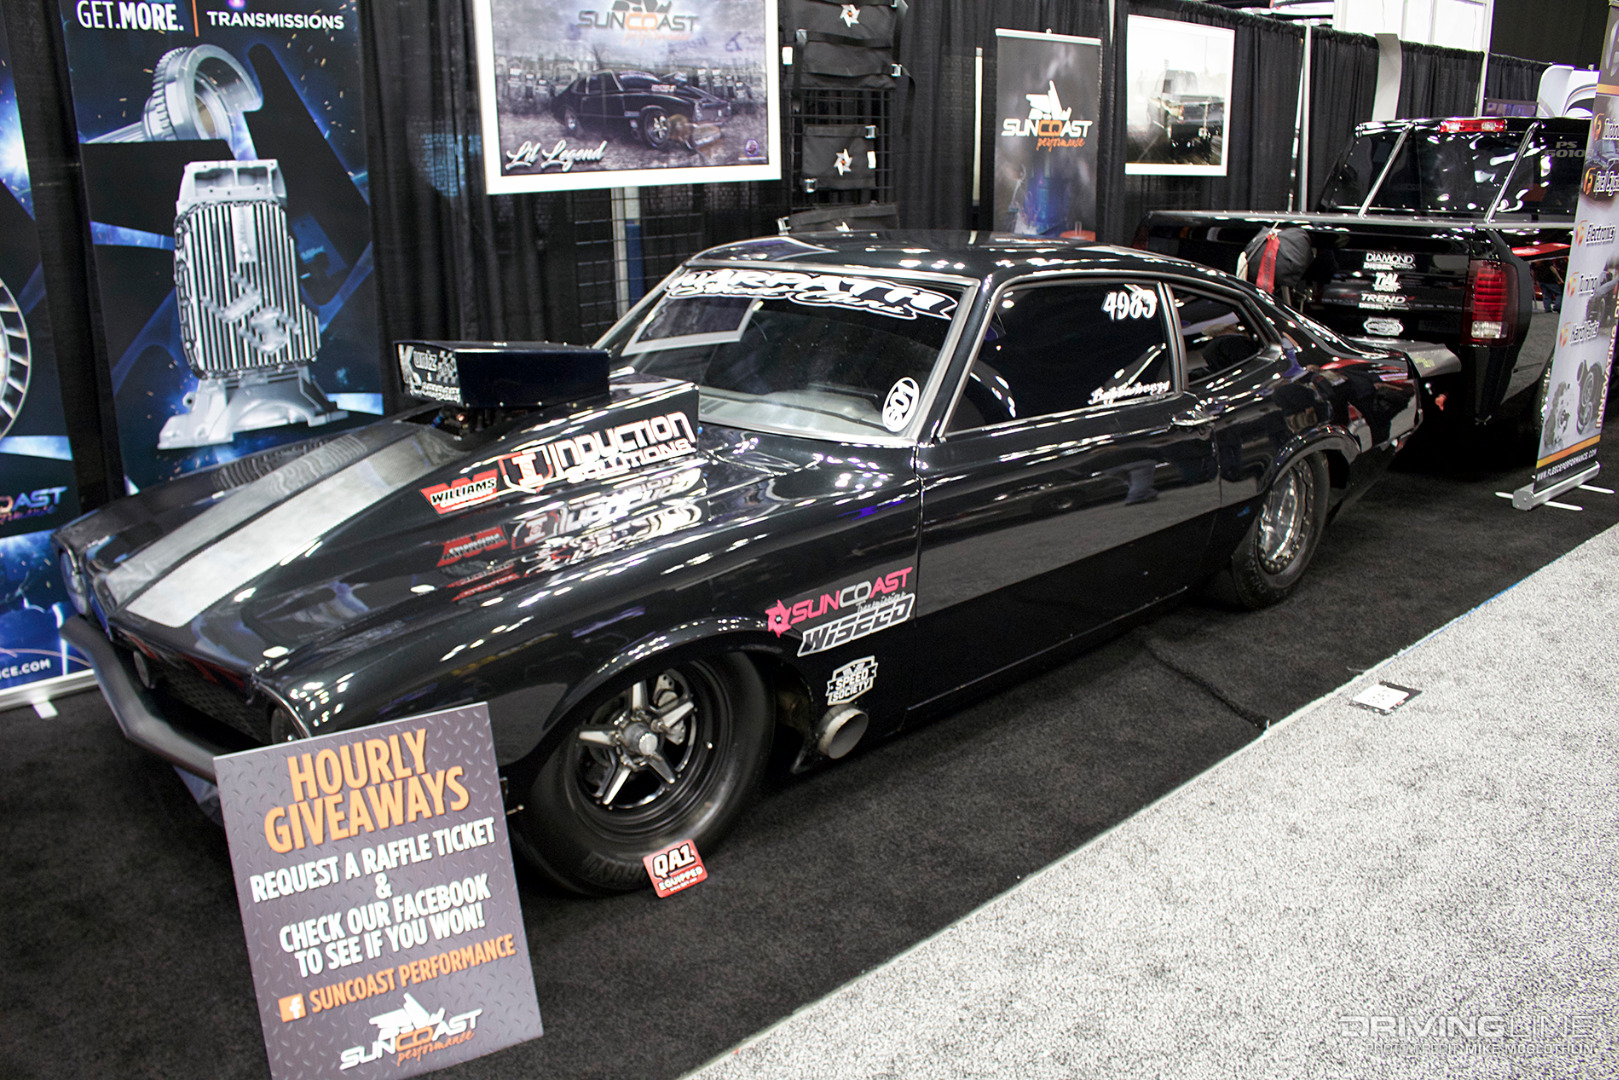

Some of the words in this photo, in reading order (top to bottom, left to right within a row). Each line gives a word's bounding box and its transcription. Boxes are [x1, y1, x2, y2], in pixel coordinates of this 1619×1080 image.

[206, 11, 345, 29] TRANSMISSIONS
[576, 10, 699, 31] SUNCOAST
[1001, 118, 1093, 137] SUNCOAST
[1555, 141, 1578, 149] PS
[505, 140, 541, 170] Lil
[541, 139, 608, 172] Legend
[1585, 223, 1616, 244] Electronics
[1366, 251, 1414, 264] DIAMOND
[668, 269, 950, 312] WARPATH
[1361, 293, 1406, 303] TREND
[1595, 325, 1618, 429] INNOVATING
[548, 411, 697, 479] INDUCTION
[564, 438, 697, 484] SOLUTIONS
[431, 478, 497, 504] WILLIAMS
[790, 566, 914, 625] SUNCOAST
[832, 679, 871, 702] SOCIETY
[834, 669, 869, 691] SPEED
[287, 728, 427, 802] HOURLY
[264, 765, 470, 853] GIVEAWAYS
[250, 856, 339, 903] REQUEST
[345, 852, 361, 880] A
[361, 834, 433, 875] RAFFLE
[432, 817, 496, 856] TICKET
[653, 844, 695, 879] QA1
[375, 872, 393, 900] &
[658, 866, 704, 891] EQUIPPED
[279, 912, 345, 953] CHECK
[347, 902, 390, 931] OUR
[394, 873, 492, 922] FACEBOOK
[295, 947, 324, 978] TO
[325, 937, 363, 970] SEE
[364, 930, 384, 957] IF
[385, 917, 429, 952] YOU
[430, 902, 486, 938] WON!
[309, 969, 396, 1013] SUNCOAST
[398, 933, 516, 988] PERFORMANCE
[339, 1008, 483, 1071] SUNCOAST
[396, 1030, 475, 1067] performance
